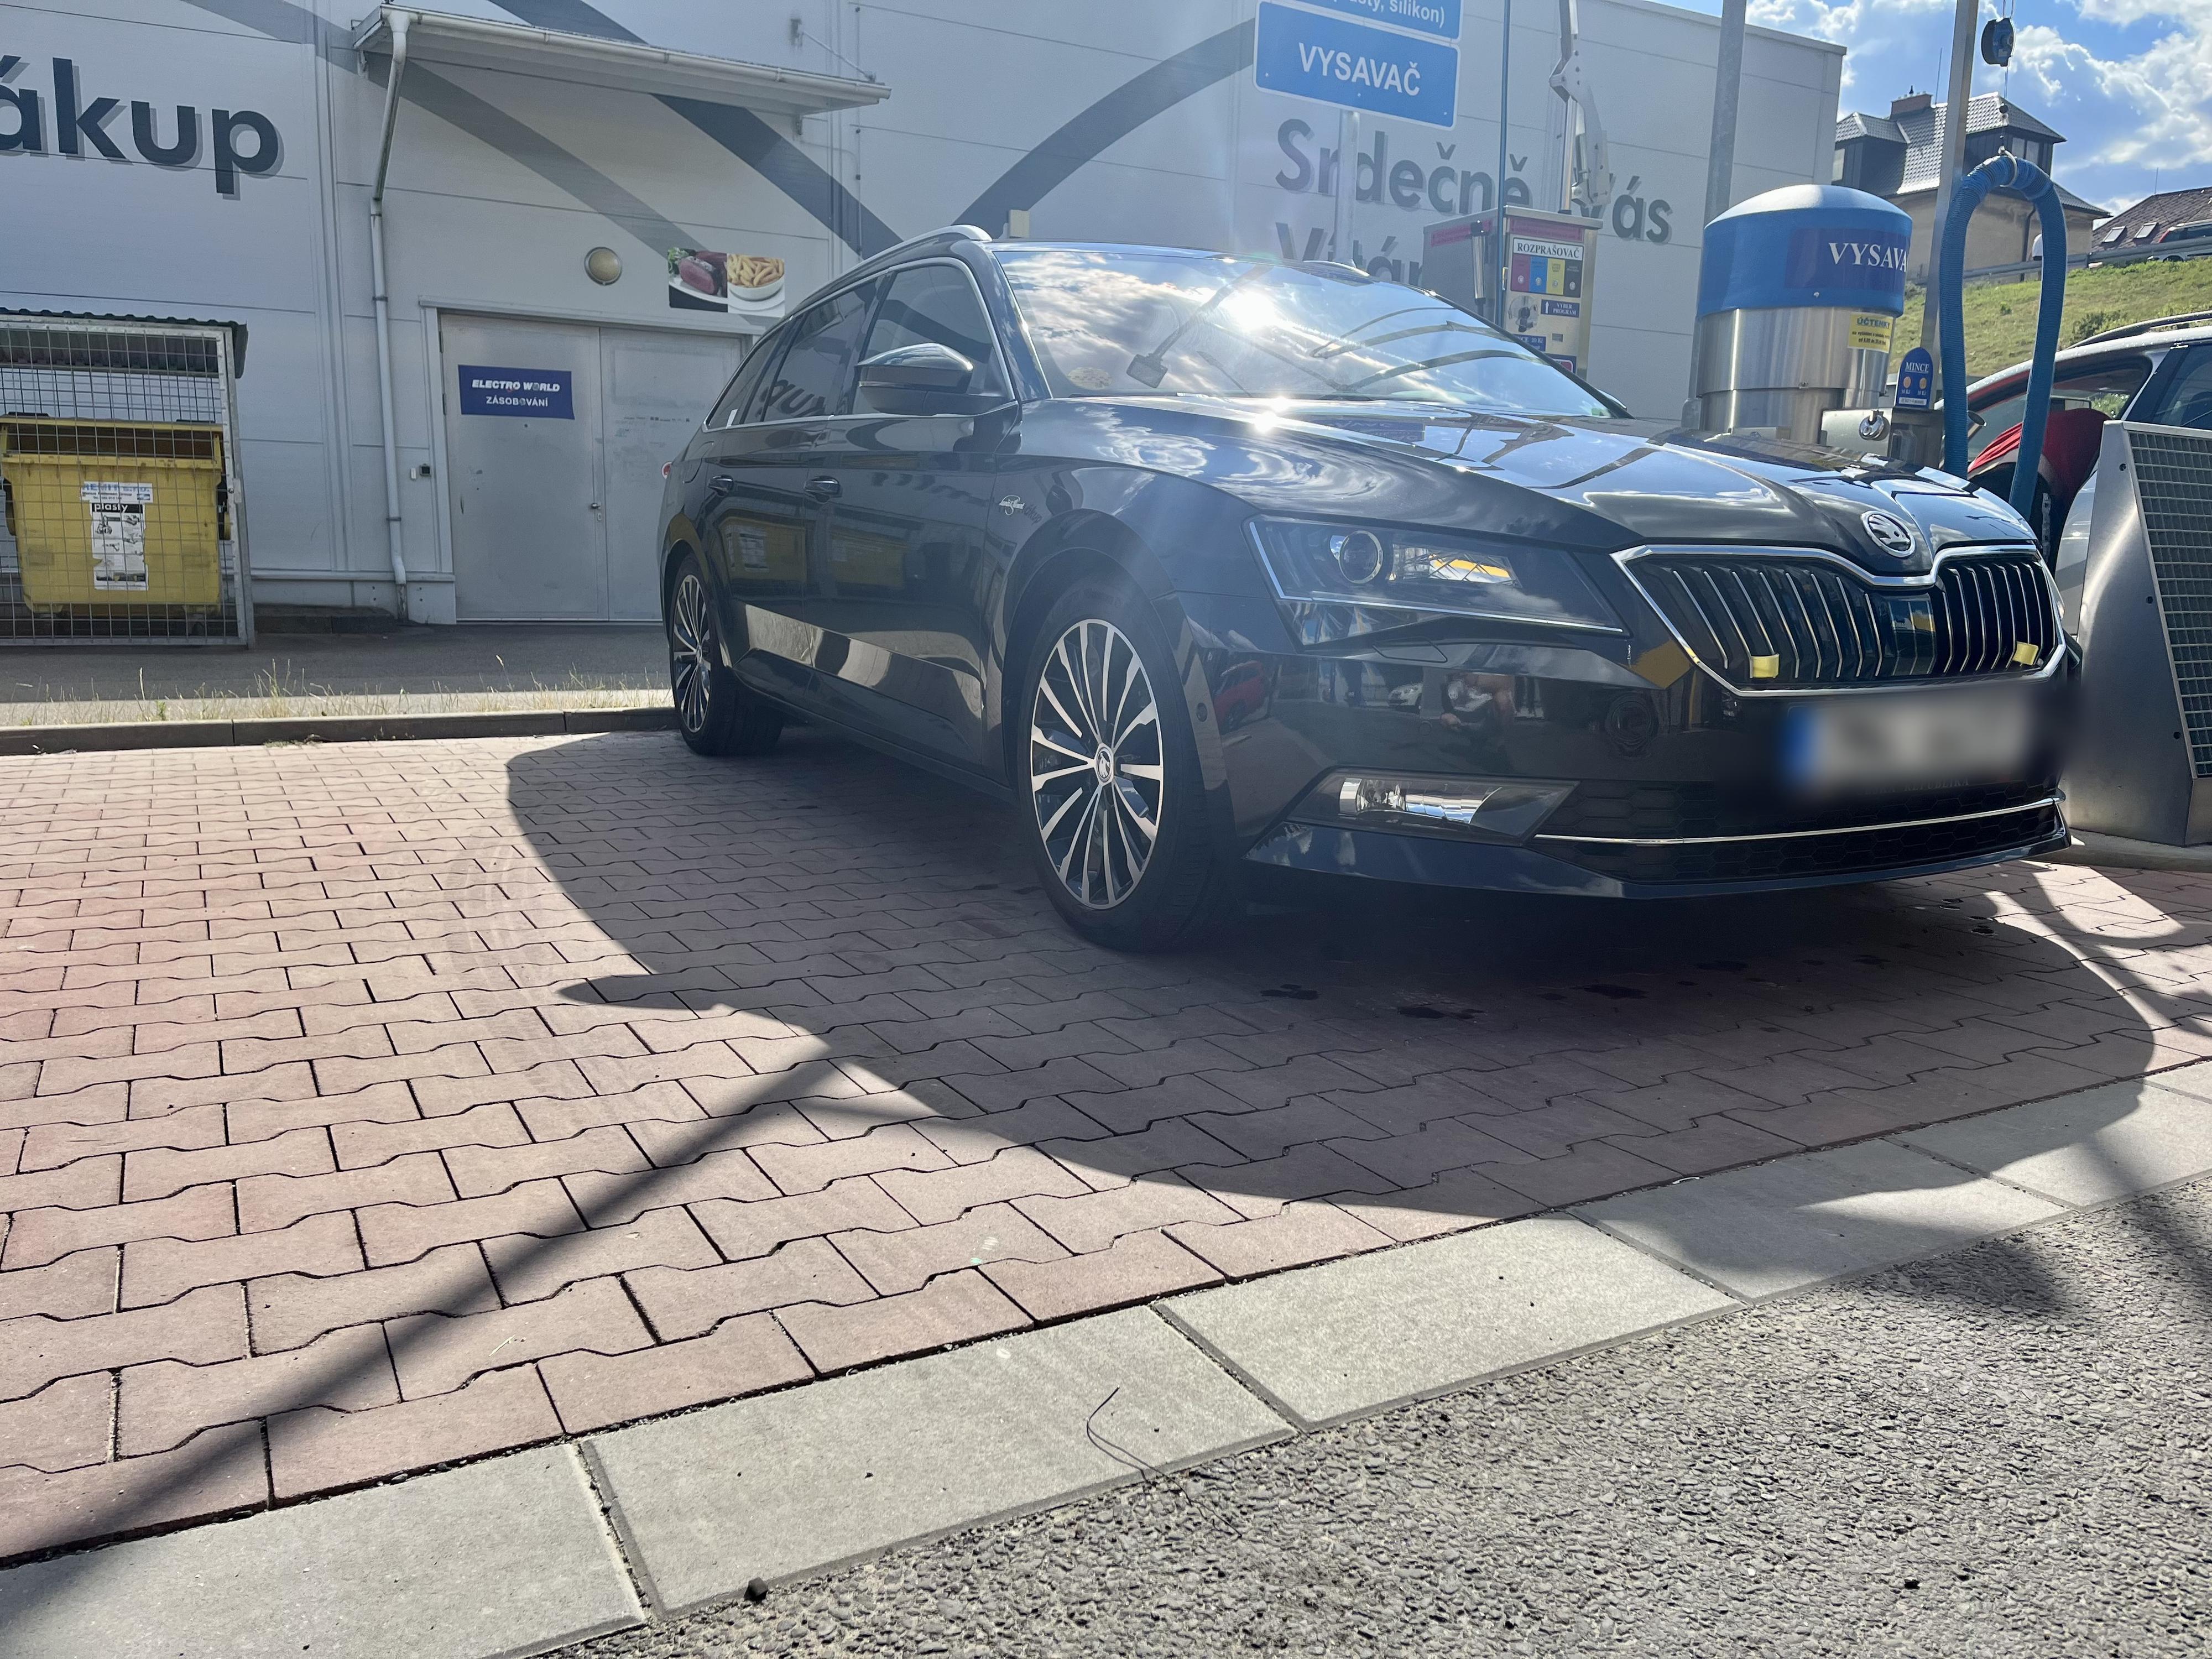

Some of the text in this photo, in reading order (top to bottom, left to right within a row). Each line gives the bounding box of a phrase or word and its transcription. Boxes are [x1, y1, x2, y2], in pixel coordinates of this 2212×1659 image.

[1389, 0, 1445, 28] silikon)
[1298, 42, 1421, 96] VYSAVAČ
[0, 55, 280, 195] ákup
[1517, 242, 1580, 259] ROZPRAŠOVAČ
[1905, 362, 1929, 372] MINCE
[472, 379, 561, 392] ELECTRO WORLD
[486, 395, 549, 406] ZÁSOBOVÁNÍ
[94, 502, 128, 512] plasty
